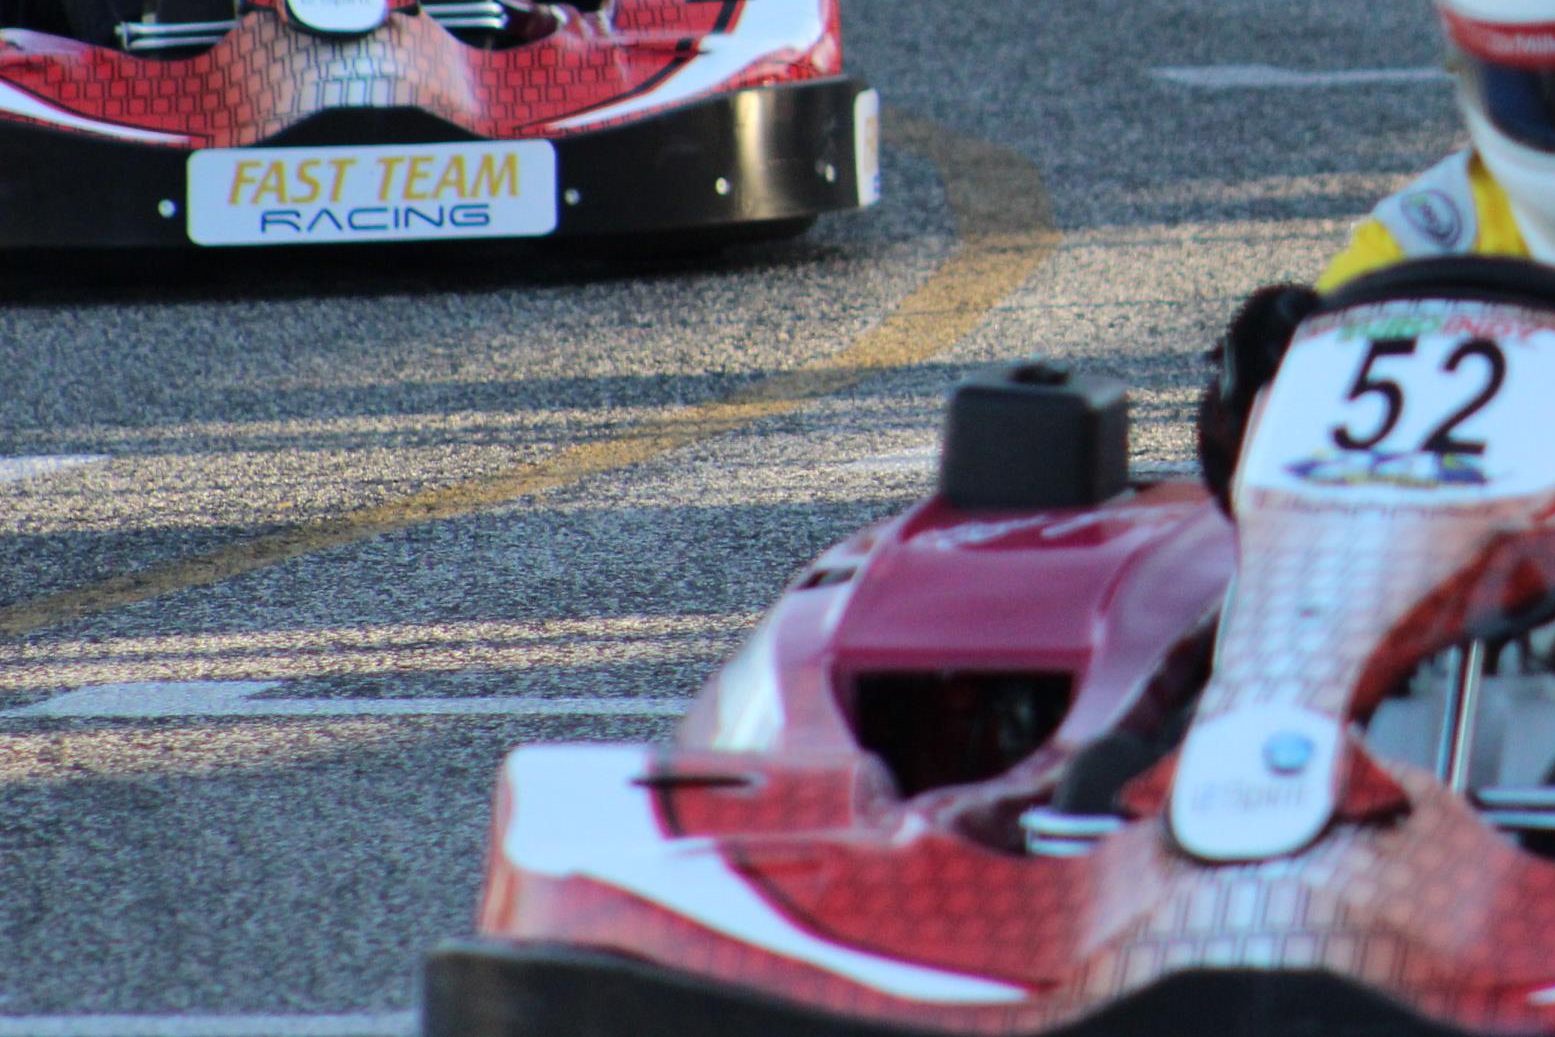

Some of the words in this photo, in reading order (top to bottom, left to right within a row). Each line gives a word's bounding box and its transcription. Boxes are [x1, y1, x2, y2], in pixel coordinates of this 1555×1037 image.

[228, 156, 357, 206] FAST
[376, 152, 520, 202] TEAM
[260, 203, 491, 233] RACING
[1331, 338, 1508, 456] 52
